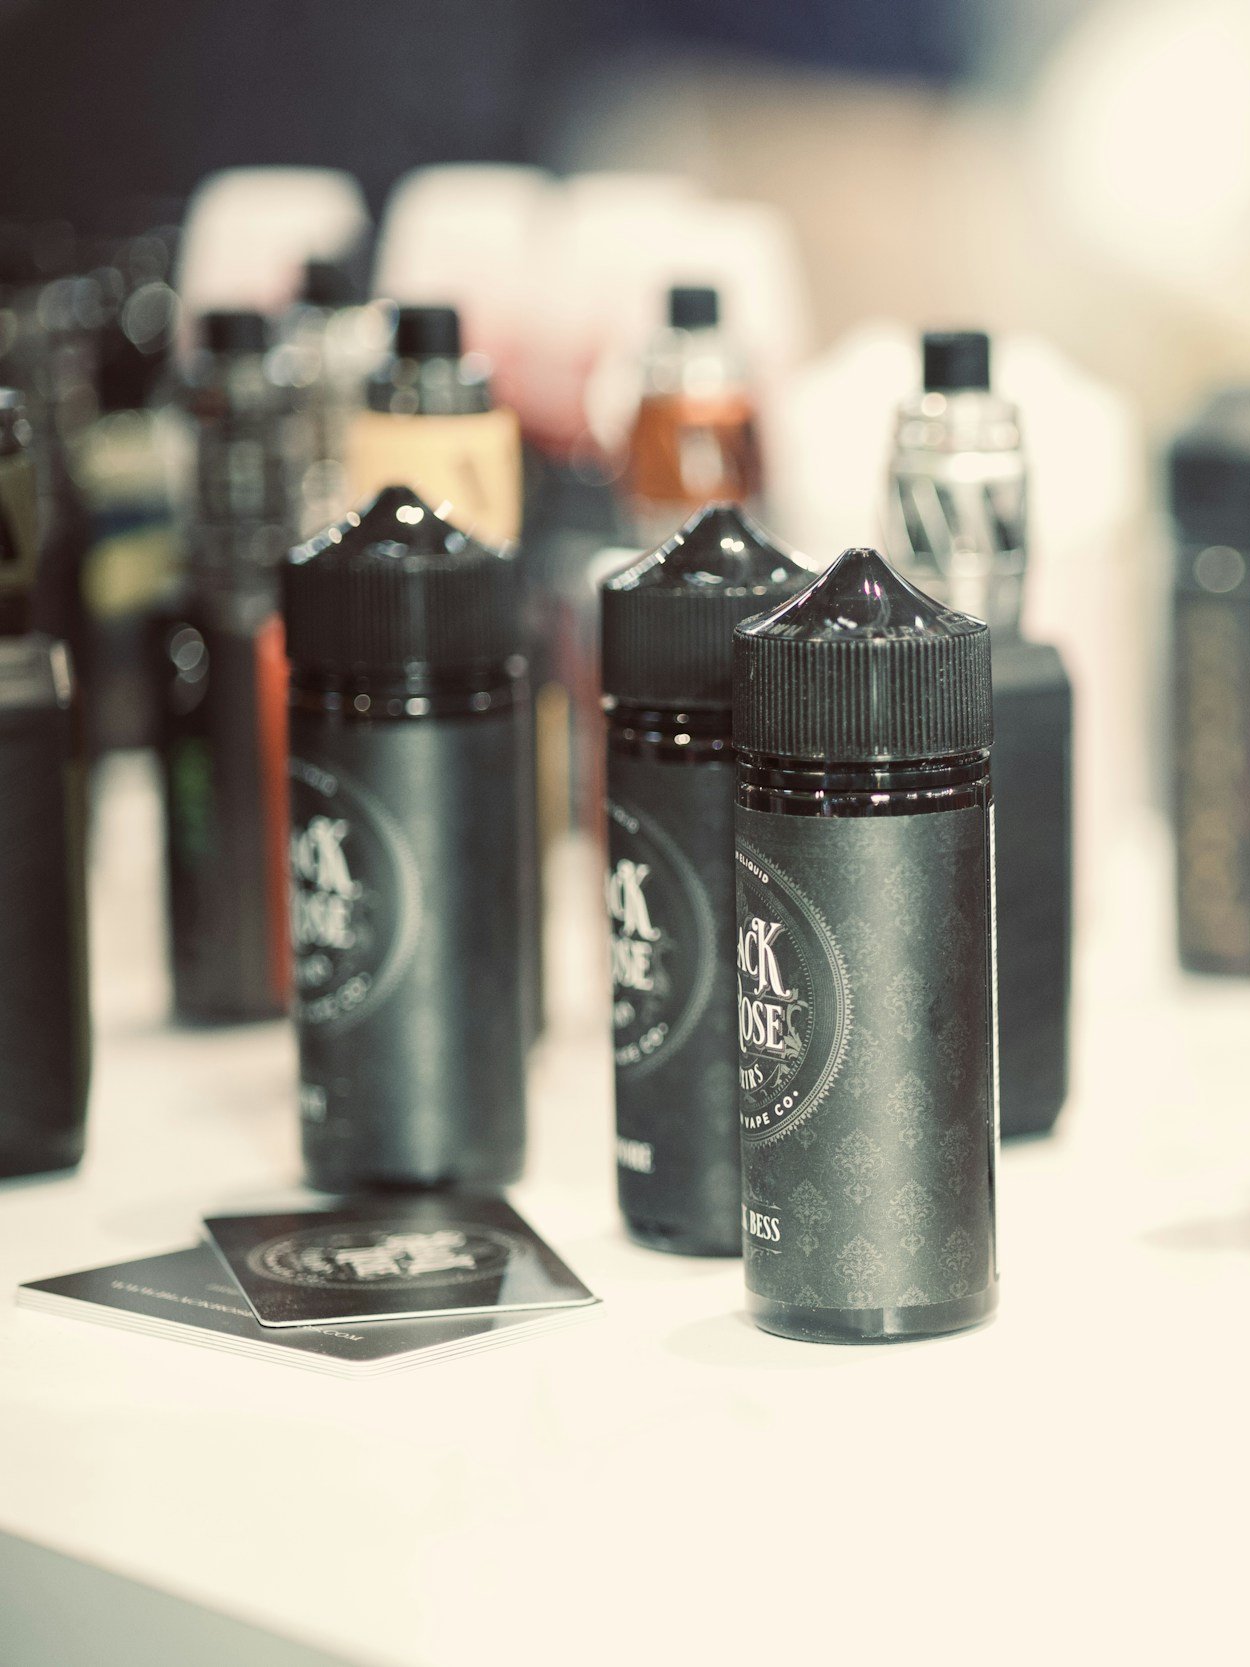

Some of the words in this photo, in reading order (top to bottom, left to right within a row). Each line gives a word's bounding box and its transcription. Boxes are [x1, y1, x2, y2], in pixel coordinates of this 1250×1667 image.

[739, 852, 769, 884] ELIQUID
[744, 1112, 771, 1129] VAPE
[749, 1210, 781, 1242] BESS
